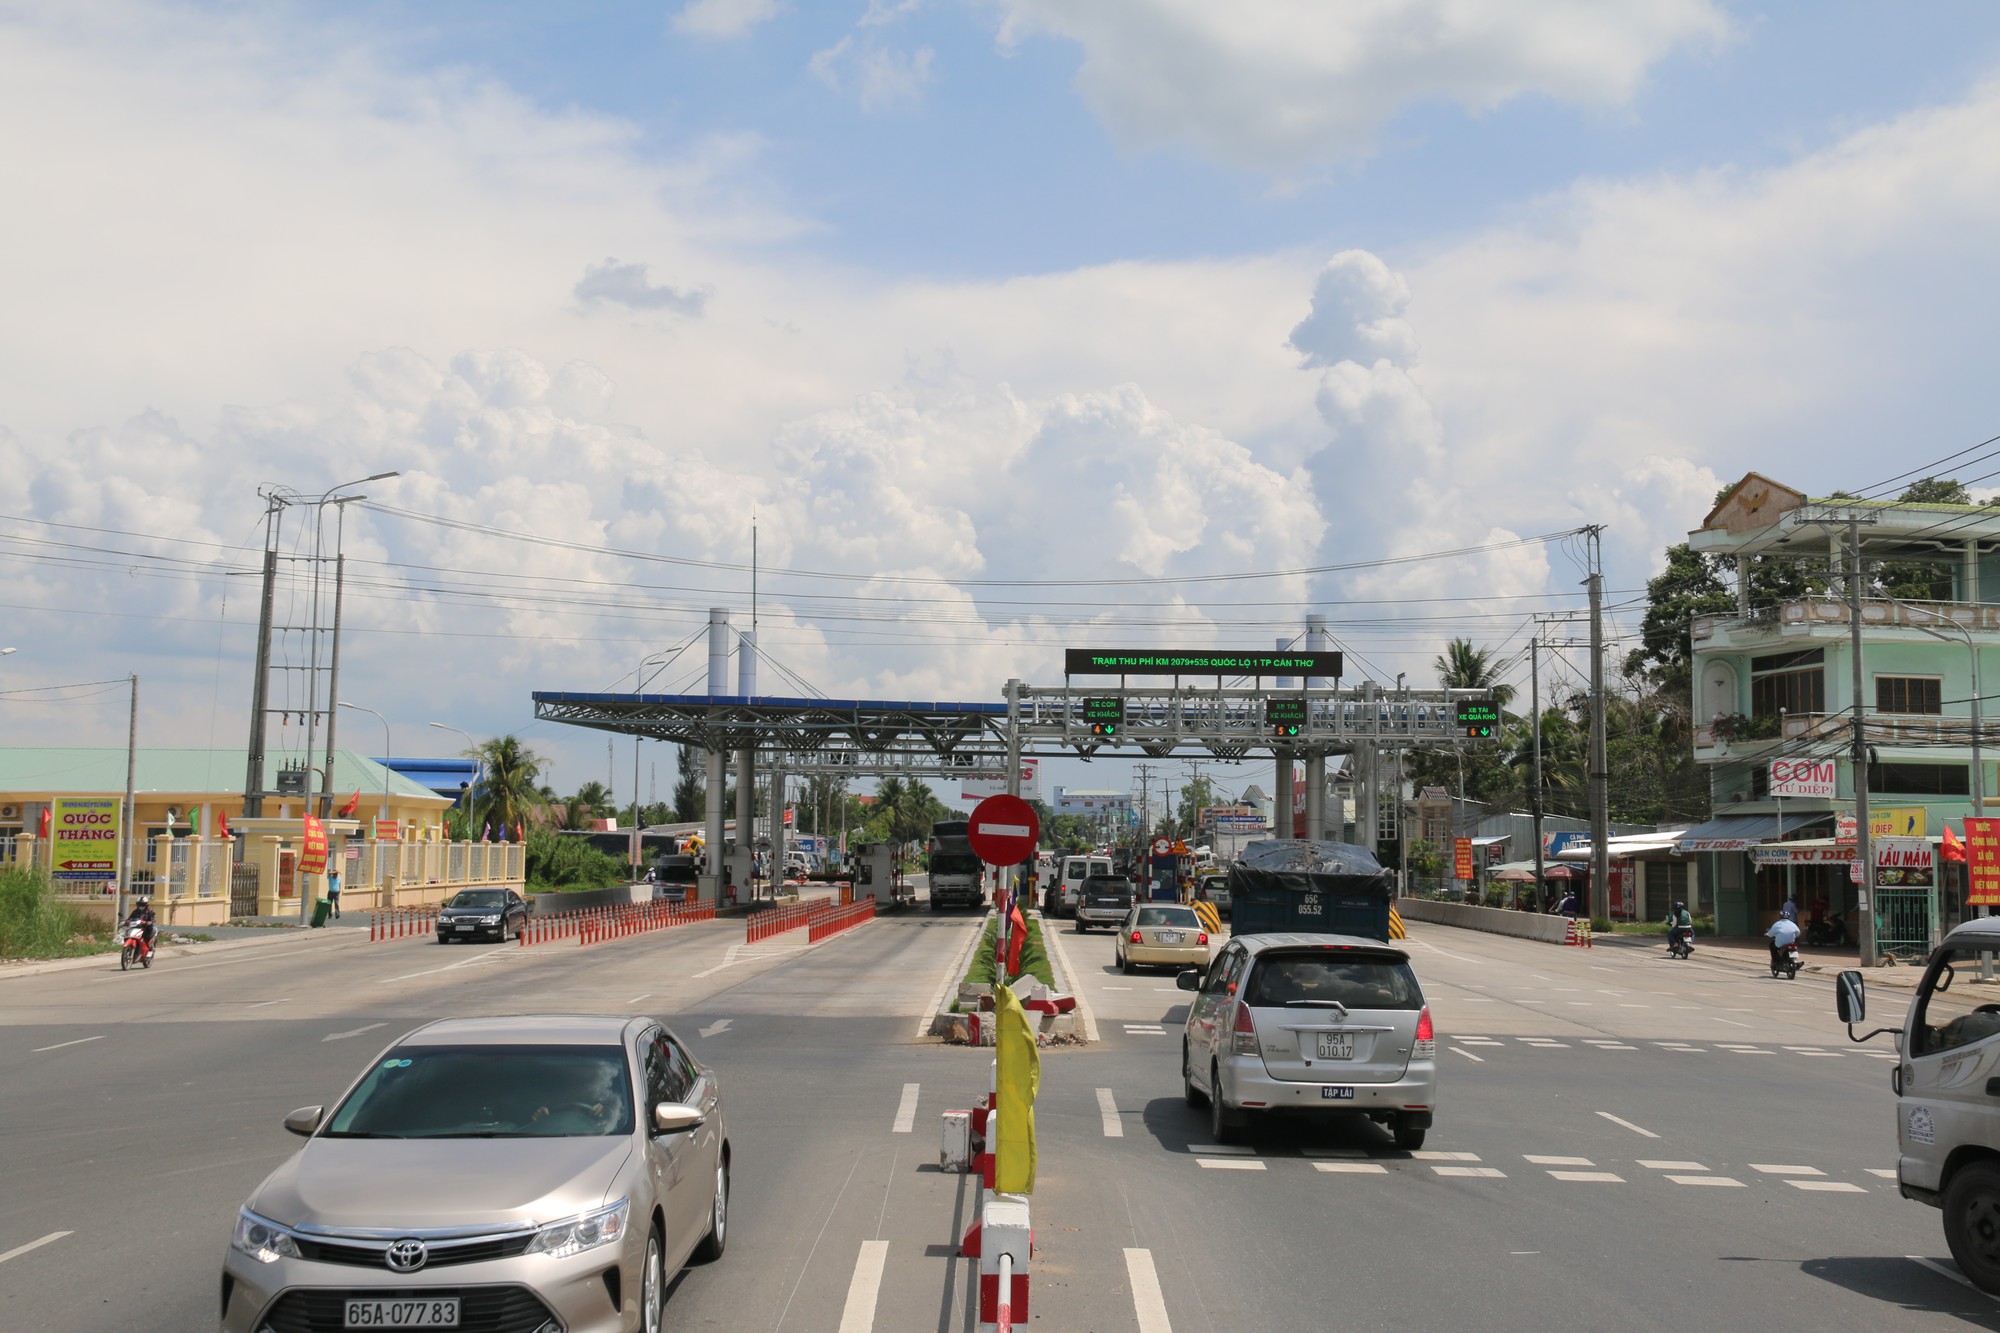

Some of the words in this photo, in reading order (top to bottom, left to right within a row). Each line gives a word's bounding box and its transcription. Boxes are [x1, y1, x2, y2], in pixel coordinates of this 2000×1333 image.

[1092, 657, 1117, 667] TRẠM
[1118, 657, 1137, 665] THU
[1156, 658, 1169, 666] KM
[1171, 658, 1209, 666] 2079+535
[1260, 659, 1271, 667] TP
[1294, 659, 1314, 667] THƠ
[1097, 710, 1120, 718] KHÁCH
[1094, 725, 1101, 734] 4
[1277, 726, 1285, 735] 5
[1470, 727, 1476, 736] 6
[1773, 760, 1833, 783] CƠM
[63, 810, 112, 825] QUỐC
[58, 826, 116, 840] THẮNG
[1820, 848, 1857, 862] DIỆ
[1878, 843, 1901, 866] LẨU
[1902, 843, 1932, 867] MẮM
[1304, 894, 1318, 904] 65C
[1298, 905, 1322, 915] 055.52
[1326, 1034, 1345, 1046] 95A
[1319, 1045, 1352, 1058] 010.17
[1323, 1087, 1339, 1099] TẬP
[1340, 1087, 1352, 1098] LÁI
[349, 1303, 455, 1325] 65A-077.83
